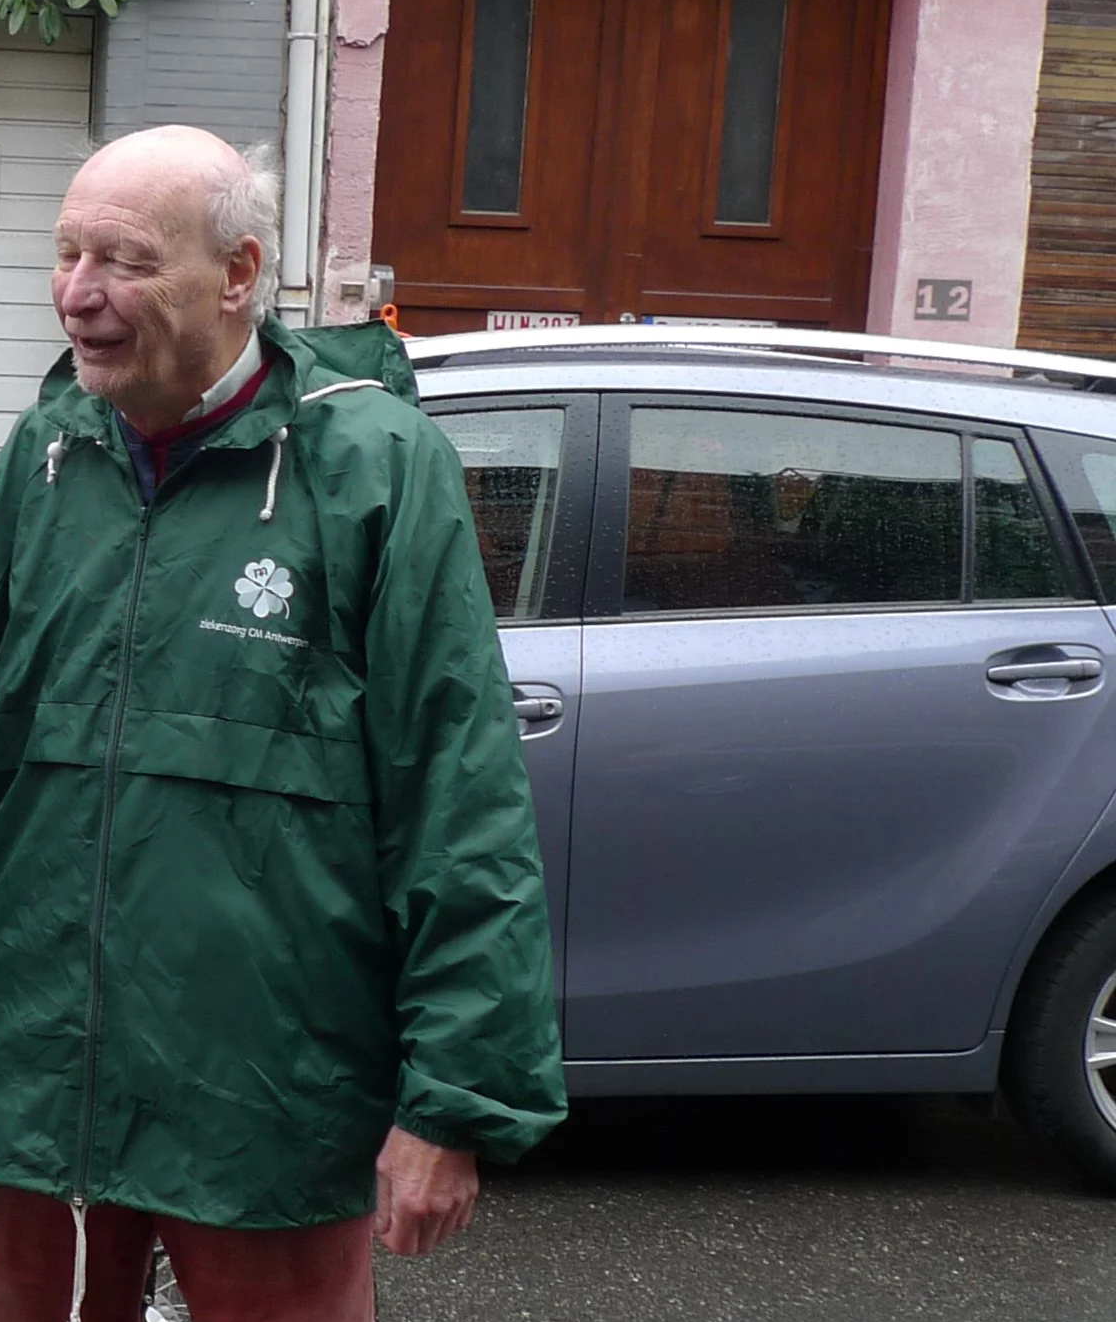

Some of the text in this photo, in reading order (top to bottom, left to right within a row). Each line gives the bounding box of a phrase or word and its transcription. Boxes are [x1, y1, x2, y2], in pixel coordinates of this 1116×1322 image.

[916, 284, 969, 315] 12
[199, 618, 246, 638] ziekenzorg
[248, 627, 263, 638] CM
